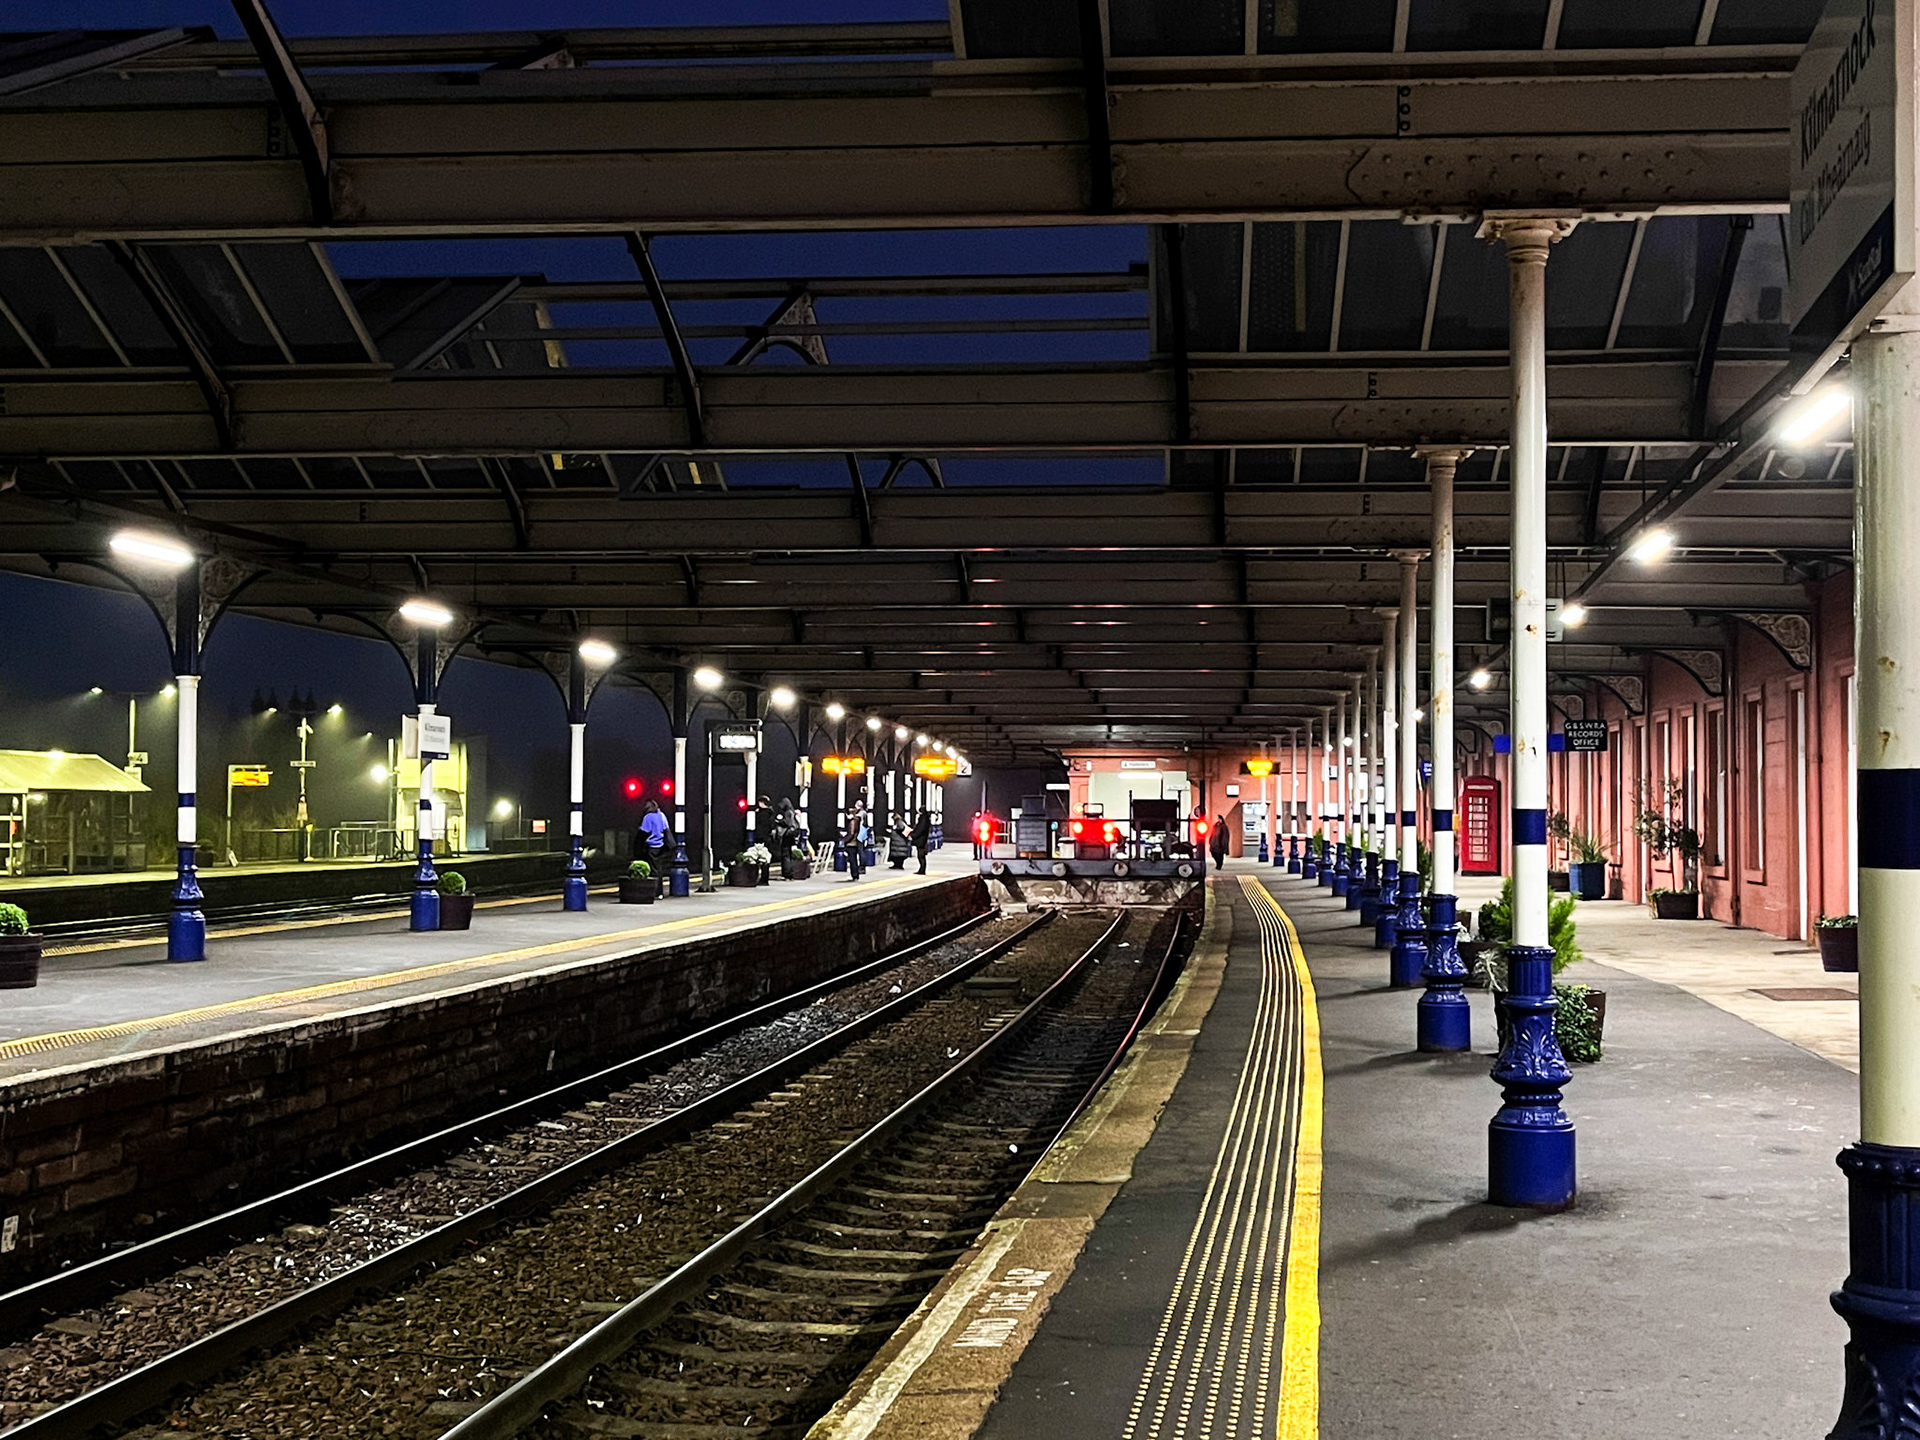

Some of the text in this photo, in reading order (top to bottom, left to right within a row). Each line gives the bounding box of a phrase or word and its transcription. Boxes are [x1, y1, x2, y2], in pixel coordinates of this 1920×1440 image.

[1802, 0, 1875, 170] Kilmarnock
[952, 1267, 1054, 1348] MIND THE GAP
